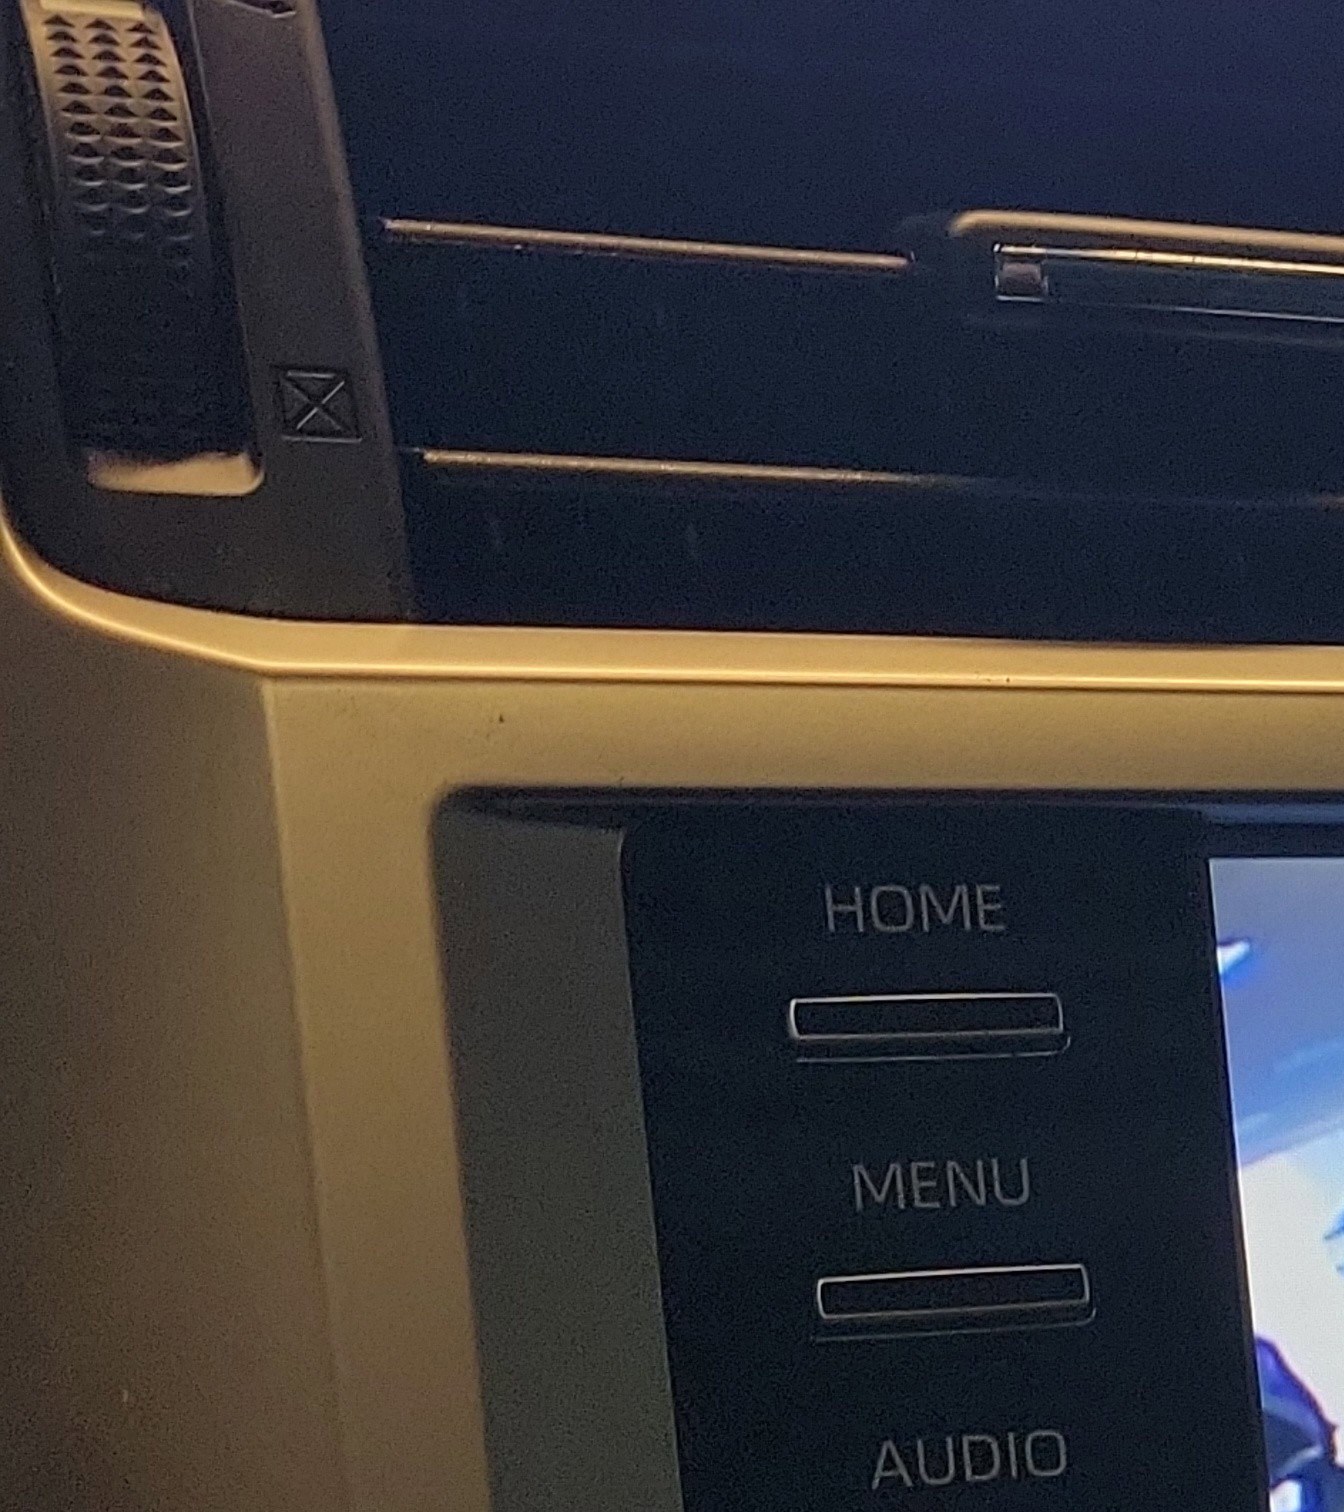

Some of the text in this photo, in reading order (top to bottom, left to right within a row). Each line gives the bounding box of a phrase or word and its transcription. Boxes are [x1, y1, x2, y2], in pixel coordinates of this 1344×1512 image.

[823, 883, 1006, 933] HOME
[850, 1157, 1031, 1212] MENU
[870, 1427, 1068, 1490] AUDIO
